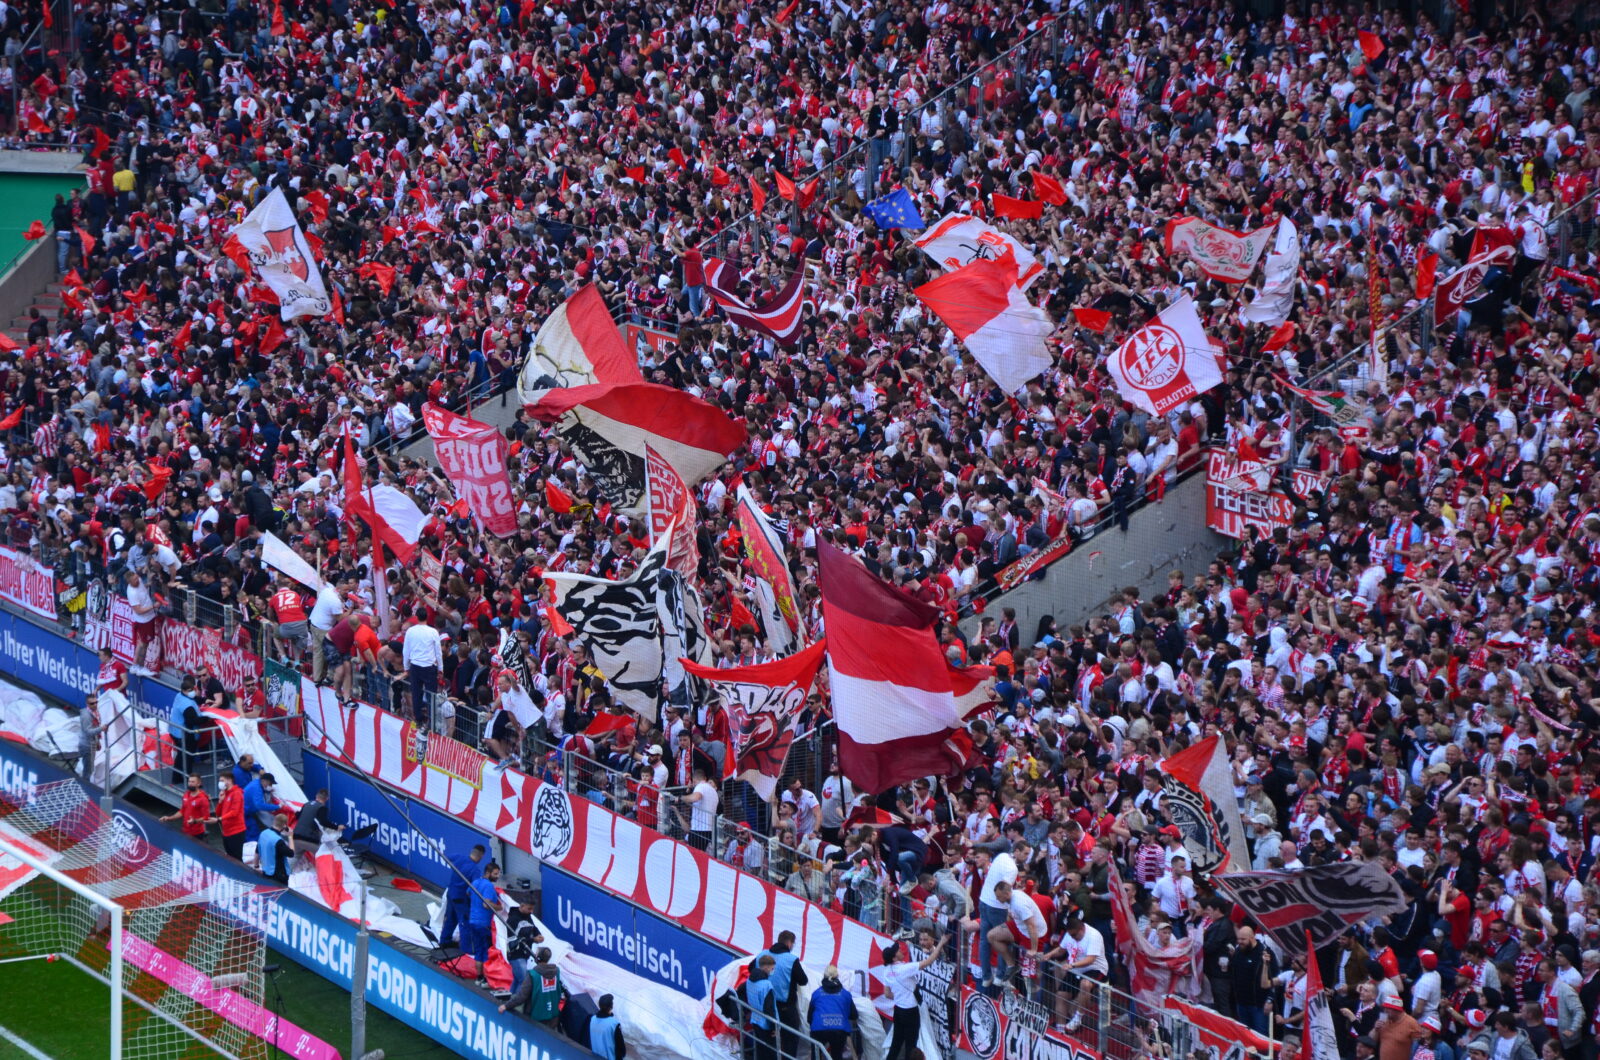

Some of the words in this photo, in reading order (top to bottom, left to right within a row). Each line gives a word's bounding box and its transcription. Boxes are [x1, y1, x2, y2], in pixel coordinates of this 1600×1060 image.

[1155, 384, 1195, 411] CHAOTIX
[278, 593, 296, 607] 12
[4, 630, 34, 668] Ihrer
[427, 732, 487, 786] STADIONVERBOT
[110, 815, 141, 857] Ford
[1238, 882, 1310, 913] CON
[172, 848, 203, 893] DER
[206, 867, 354, 979] VOLLELEKTRISCH
[367, 953, 417, 1014] FORD
[421, 990, 517, 1060] MUSTANG
[557, 895, 689, 989] Unparteiisch.
